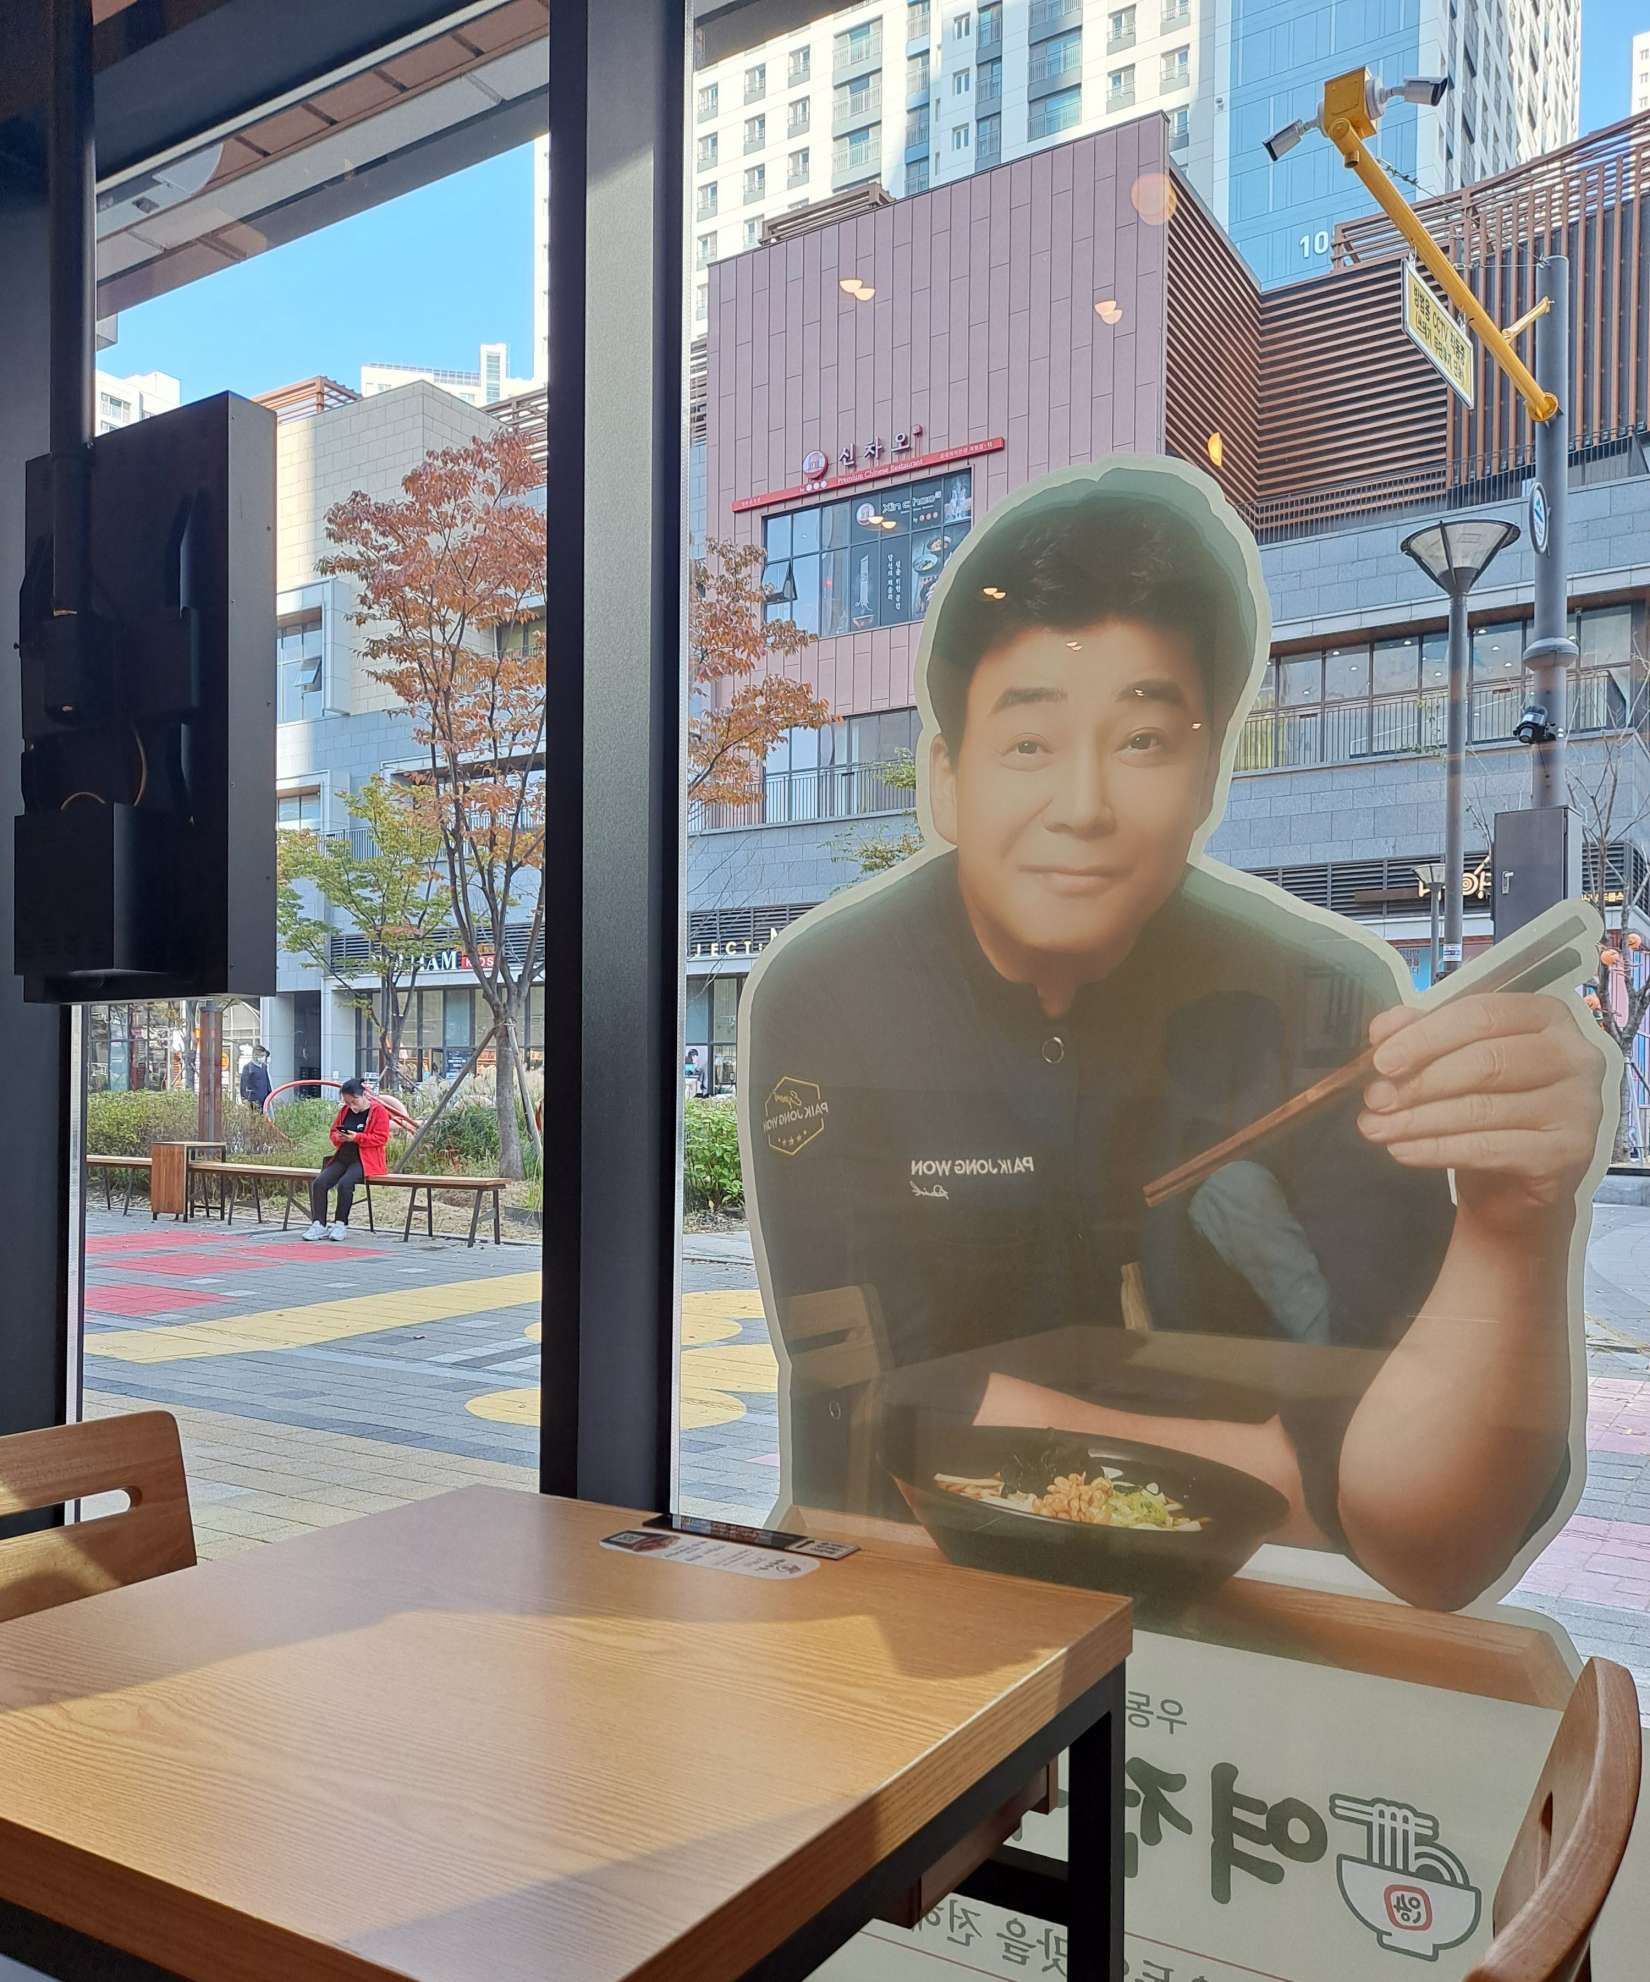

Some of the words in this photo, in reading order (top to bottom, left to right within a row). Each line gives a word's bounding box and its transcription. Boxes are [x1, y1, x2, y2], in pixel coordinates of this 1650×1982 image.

[1300, 231, 1329, 258] 10
[1433, 311, 1449, 342] CCTV
[840, 432, 912, 466] 신차오
[465, 956, 494, 969] KDS
